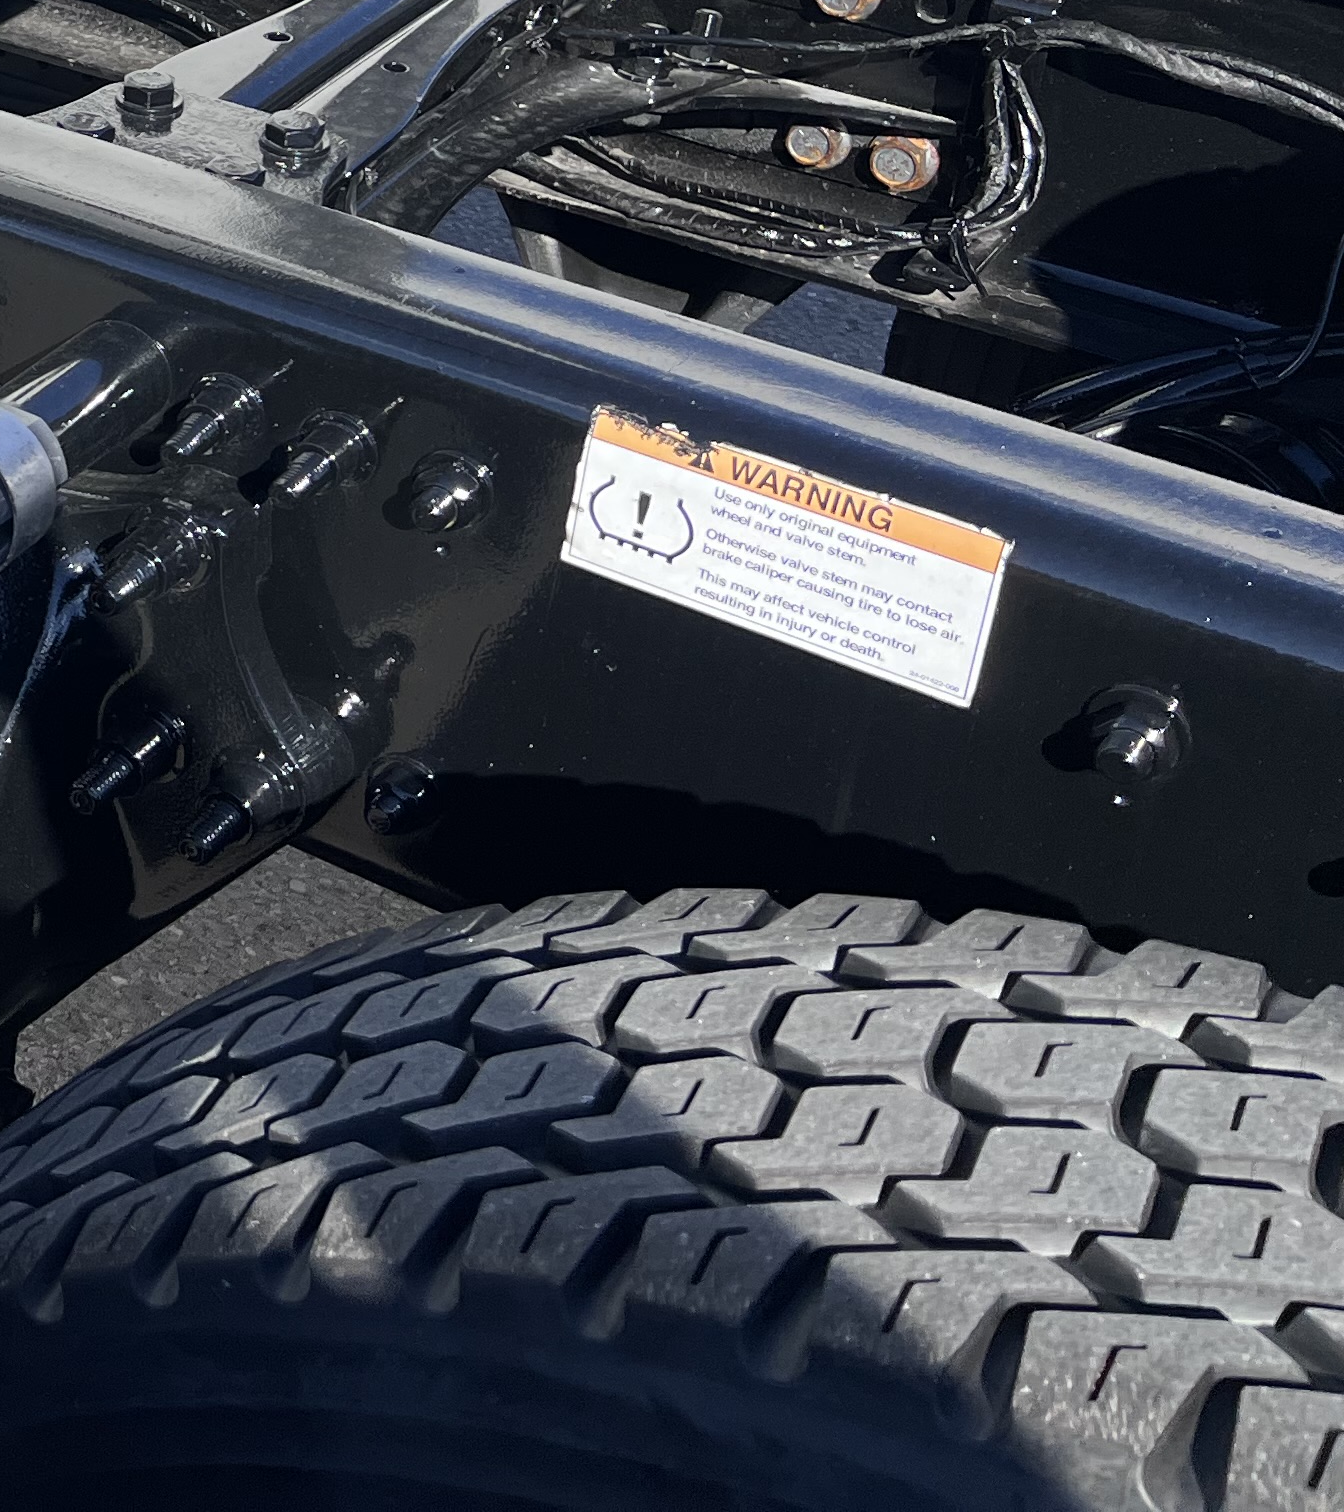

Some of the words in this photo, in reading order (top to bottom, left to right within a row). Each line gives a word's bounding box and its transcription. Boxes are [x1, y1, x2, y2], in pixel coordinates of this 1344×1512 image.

[714, 486, 742, 506] Use
[744, 498, 776, 519] only
[779, 510, 834, 539] original
[837, 529, 917, 567] equipment
[731, 455, 893, 533] WARNING
[706, 528, 777, 561] Otherwise
[781, 555, 819, 576] valve
[821, 570, 858, 591] stem
[861, 584, 894, 604] may
[896, 596, 954, 624] contact
[710, 505, 751, 528] wheel
[754, 520, 782, 537] and
[786, 530, 824, 552] valve
[827, 545, 867, 567] stem.
[694, 586, 756, 617] resulting
[758, 606, 773, 621] in
[776, 612, 818, 638] injury
[820, 631, 837, 643] or
[839, 638, 885, 662] death.
[698, 567, 727, 587] This
[730, 581, 761, 600] may
[763, 593, 805, 615] affect
[808, 608, 860, 635] vehicle
[862, 629, 916, 655] control
[702, 542, 743, 566] brake
[745, 560, 794, 583] caliper
[796, 577, 855, 607] causing
[858, 597, 883, 616] tire
[886, 607, 901, 622] to
[905, 614, 938, 634] lose
[940, 629, 965, 646] air.
